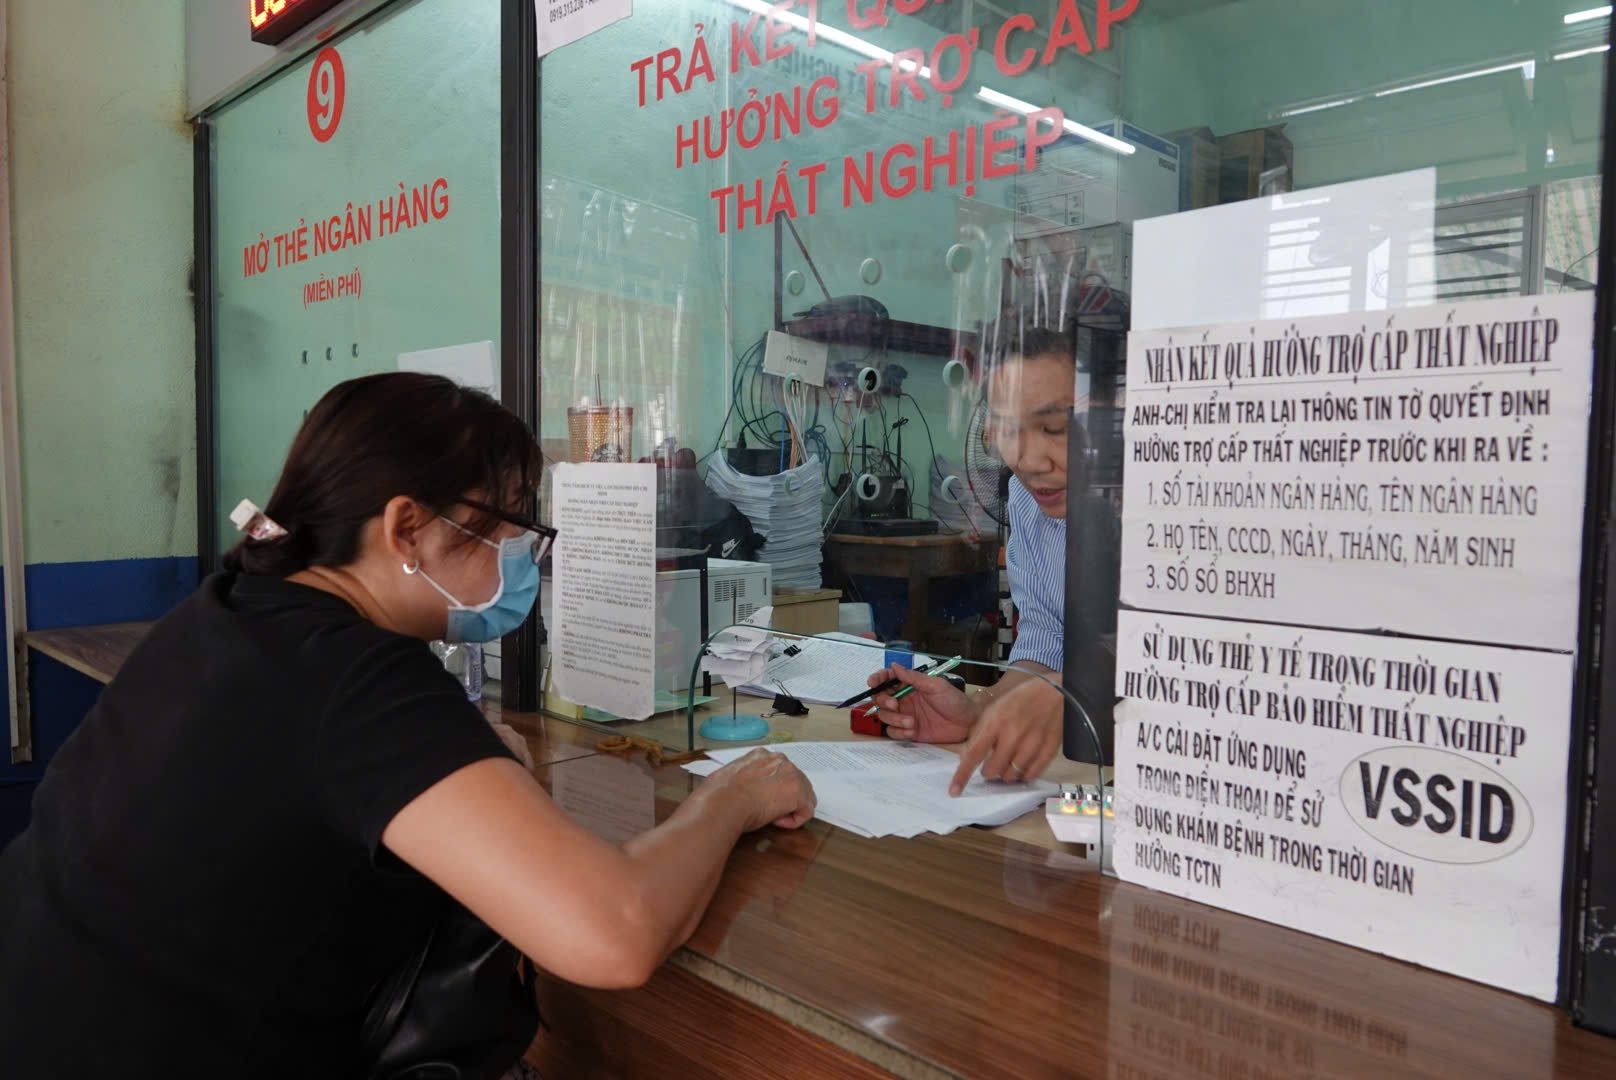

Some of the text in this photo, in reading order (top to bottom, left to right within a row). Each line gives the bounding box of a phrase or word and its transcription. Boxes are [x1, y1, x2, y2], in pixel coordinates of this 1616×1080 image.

[316, 59, 336, 131] 9
[630, 23, 715, 108] TRẢ
[675, 88, 839, 169] HƯỞNG
[855, 28, 979, 113] TRỢ
[710, 106, 1065, 233] THẤT NGHIỆP
[243, 177, 449, 278] MỞ THẺ NGÂN HÀNG
[337, 267, 362, 300] PHÍ)
[1144, 305, 1560, 393] NHẬN KẾT QUẢ HƯỞNG TRỢ CẤP THẤT NGHIỆP
[1131, 381, 1550, 430] ANH-CHỊ KIỂM TRA LẠI THÔNG TIN TỜ QUYẾT ĐỊNH
[1133, 433, 1179, 462] HƯỞNG
[1184, 437, 1214, 467] TRỢ
[1217, 431, 1248, 462] CẤP
[1253, 430, 1293, 462] THẤT
[1299, 432, 1361, 468] NGHIỆP
[1367, 431, 1427, 463] TRƯỚC
[1433, 437, 1466, 463] KHI
[1474, 436, 1500, 463] RA
[1148, 469, 1538, 516] 1. SỐ TÀI KHOẢN NGÂN HÀNG, TÊN NGÂN HÀNG
[1146, 517, 1515, 568] 2. HỌ TÊN, CCCD, NGÀY, THÁNG, NĂM SINH
[1146, 553, 1276, 599] 3. SỐ SỔ BHXH
[1143, 622, 1502, 703] SỬ DỤNG THẺ Y TẾ TRONG THỜI GIAN
[1124, 664, 1526, 765] HƯỞNG TRỢ CẤP BẢO HIỂM THẤT NGHIỆP
[1137, 721, 1306, 780] A/C CÀI ĐẶT ỨNG DỤNG
[1136, 763, 1325, 828] TRONG ĐIỆN THOẠI ĐỂ SỬ
[1359, 760, 1515, 844] VSSID
[1135, 803, 1414, 896] DỤNG KHÁM BỆNH TRONG THỜI GIAN
[1135, 838, 1222, 889] HƯỞNG TCTN
